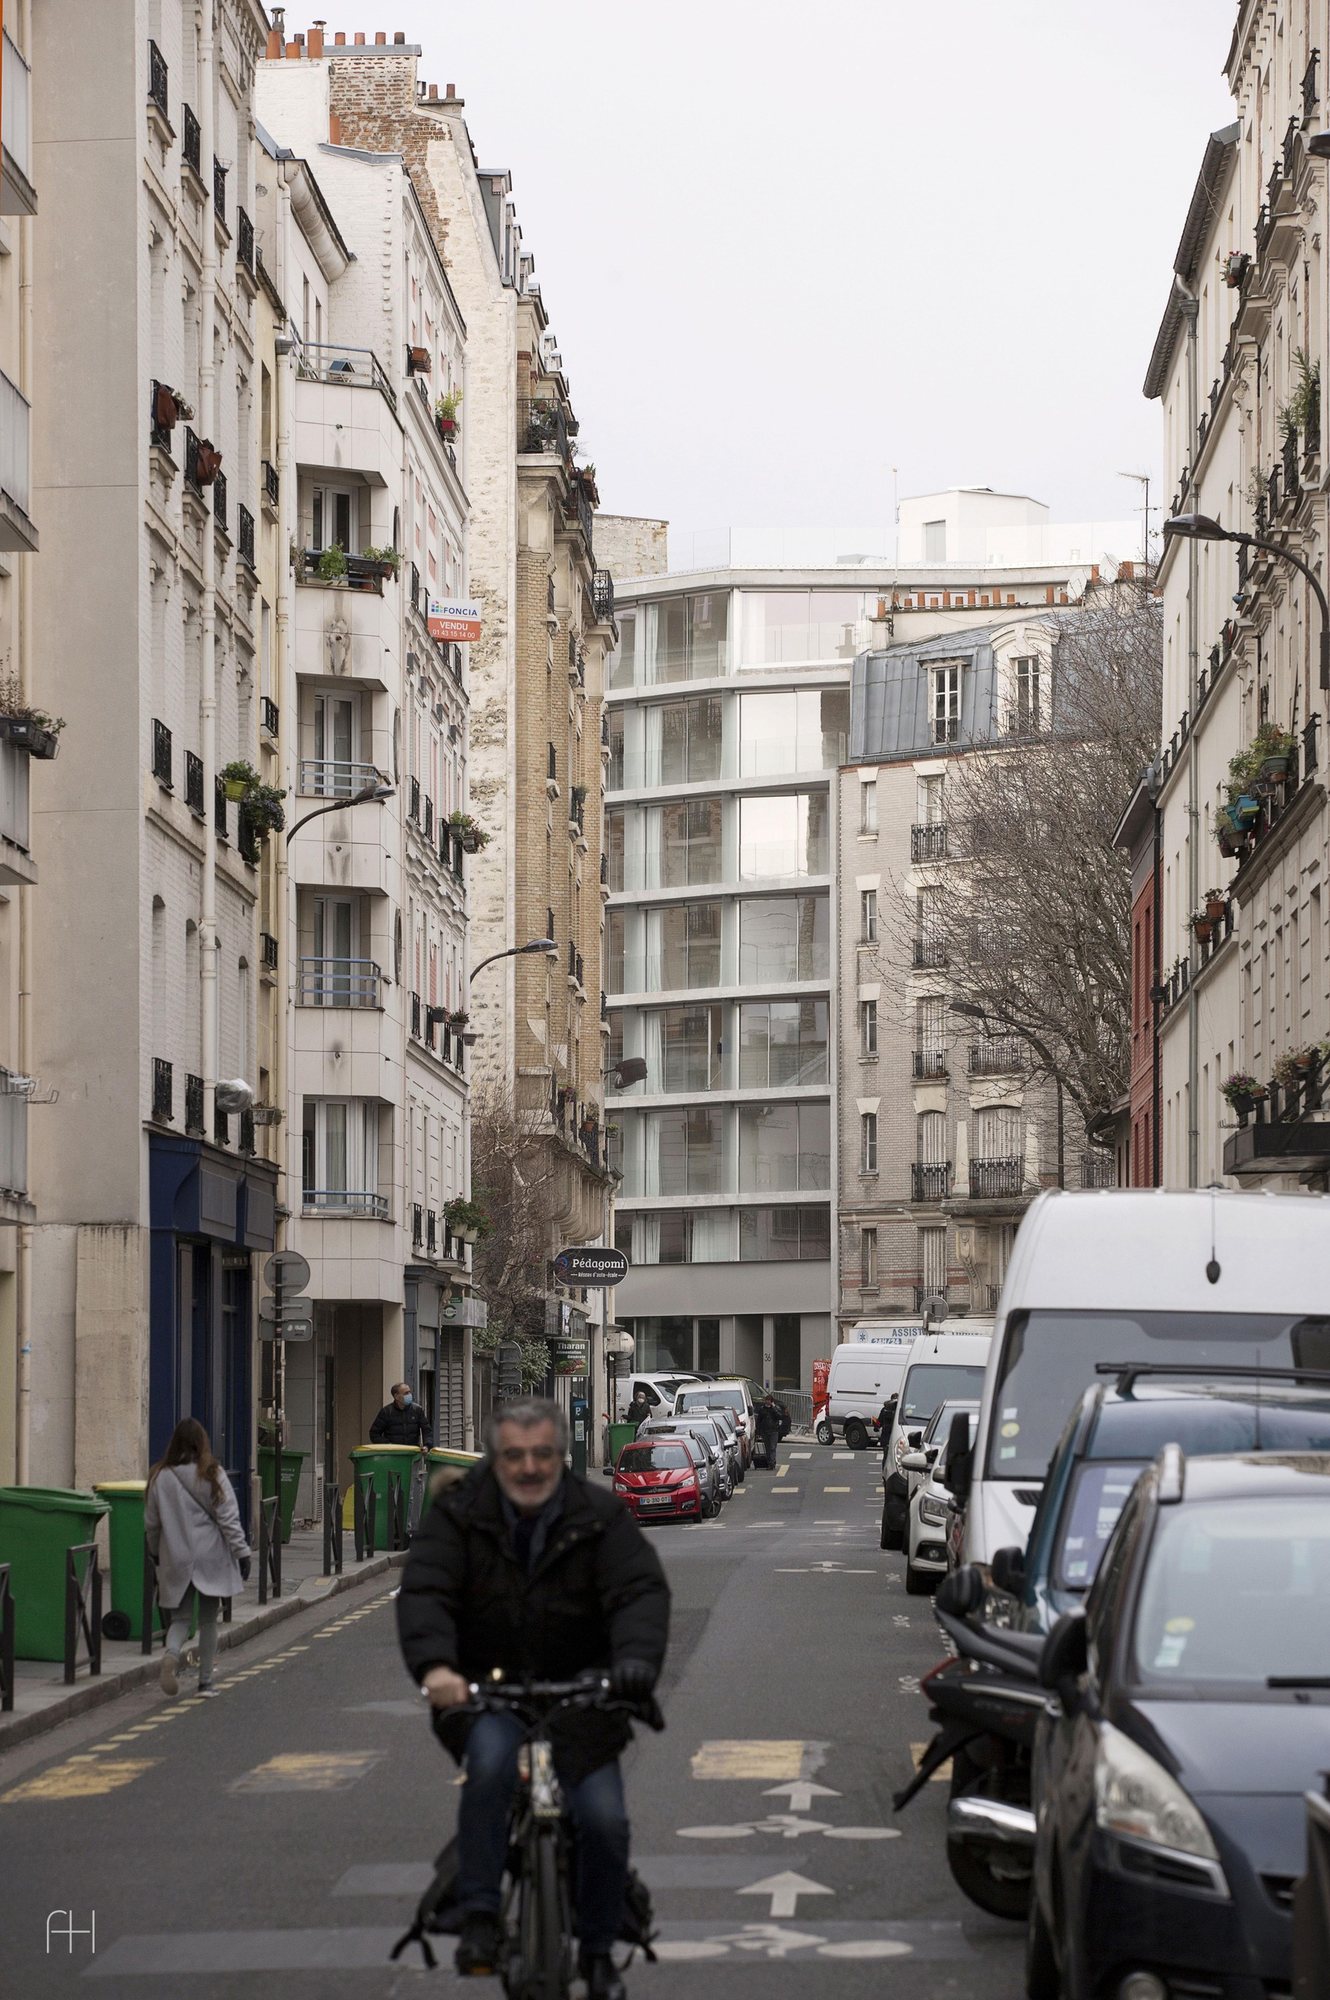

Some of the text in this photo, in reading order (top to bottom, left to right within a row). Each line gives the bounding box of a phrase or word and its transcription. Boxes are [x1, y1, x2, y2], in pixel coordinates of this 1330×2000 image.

[443, 607, 478, 616] FONCIA
[440, 621, 469, 631] VENDU
[572, 1258, 624, 1271] Pédagomi
[557, 1342, 586, 1350] Tharan
[764, 1353, 772, 1362] 36
